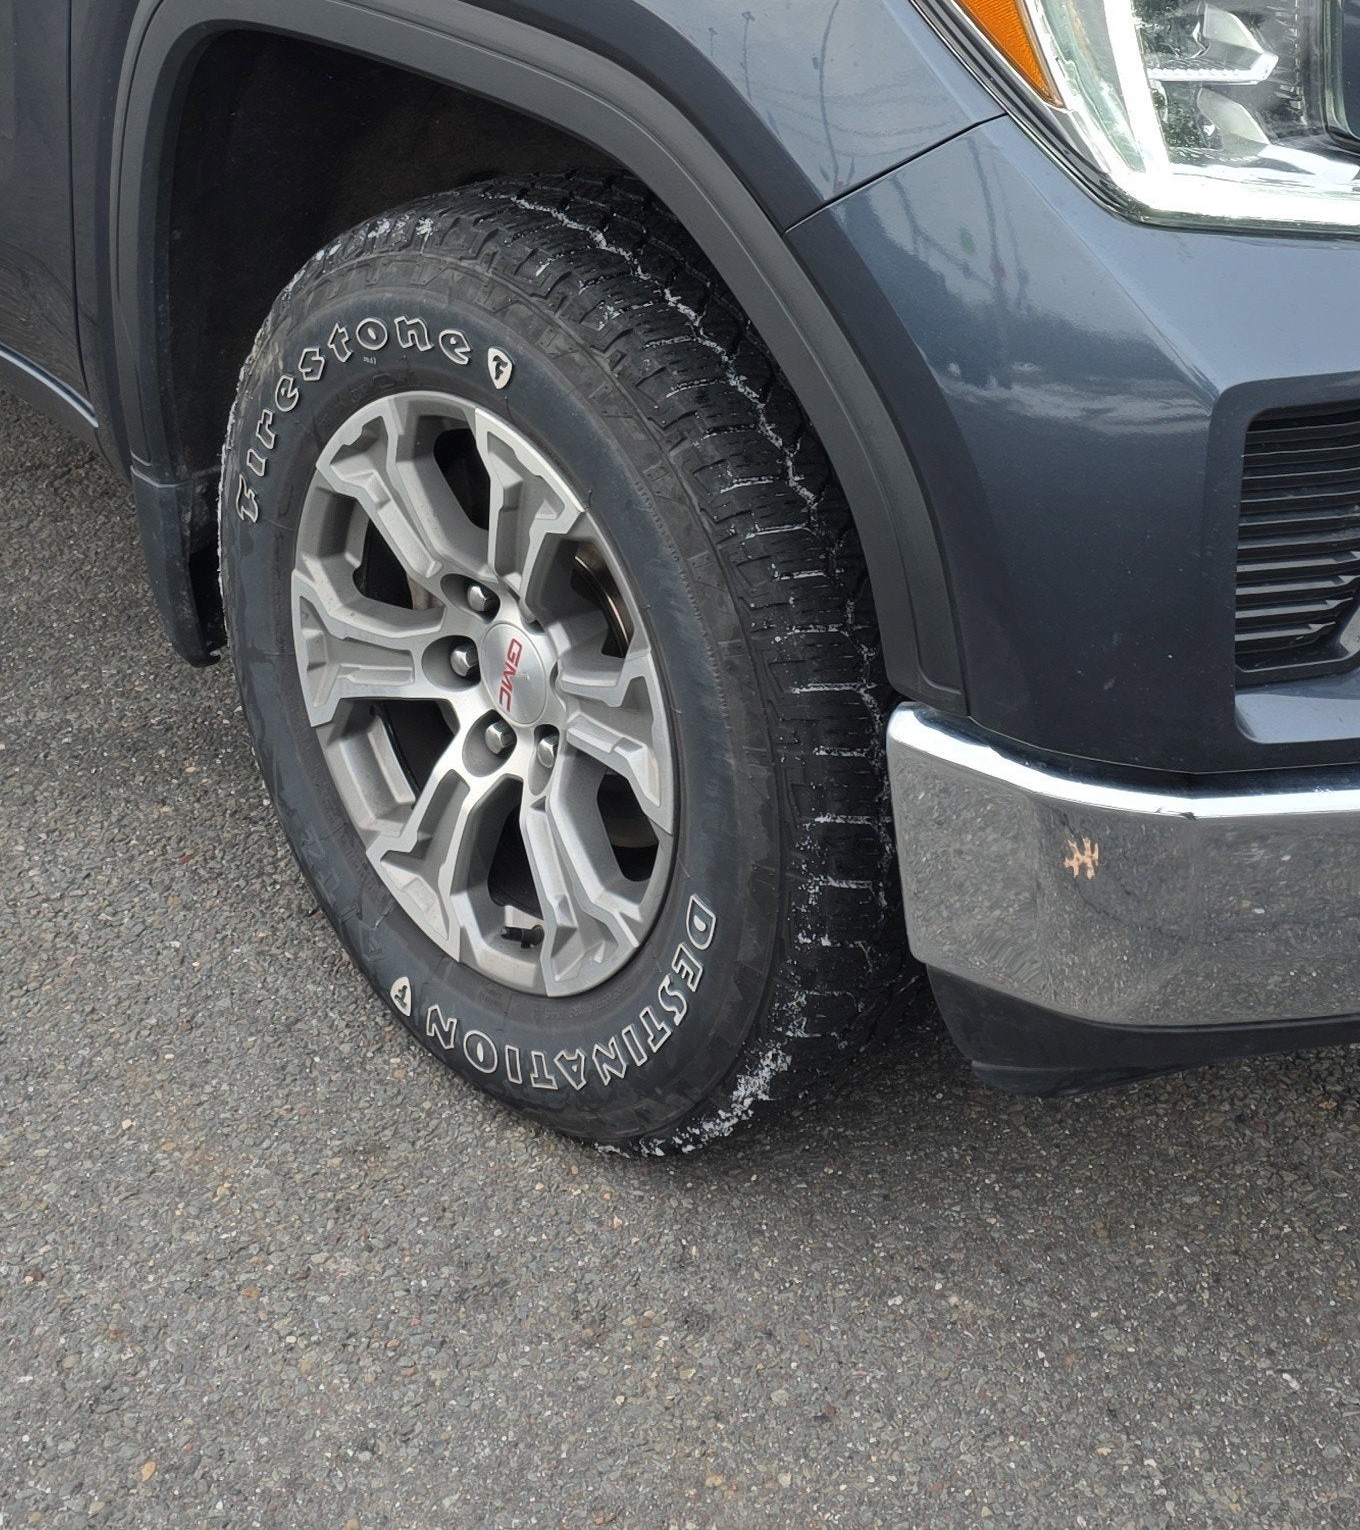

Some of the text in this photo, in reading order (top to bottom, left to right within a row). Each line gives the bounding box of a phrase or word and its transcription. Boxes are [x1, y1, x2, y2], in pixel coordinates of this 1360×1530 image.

[235, 315, 473, 524] Firestone
[498, 637, 523, 713] GMC
[426, 893, 717, 1091] DESTINATION
